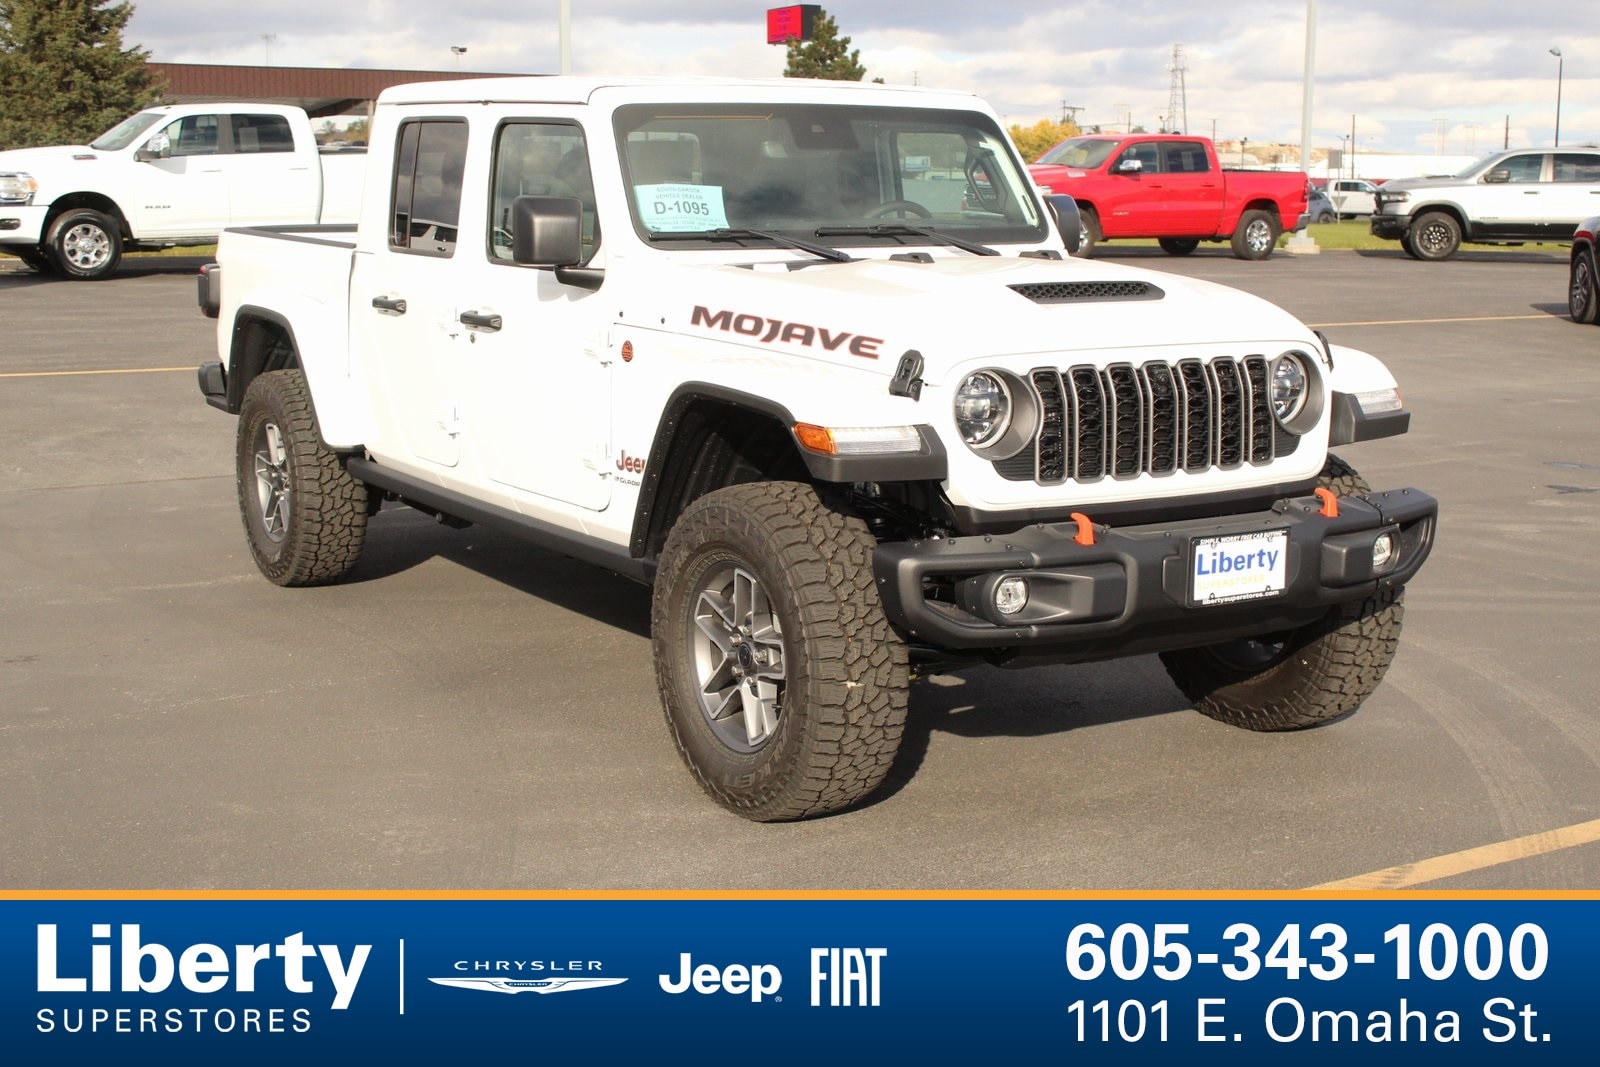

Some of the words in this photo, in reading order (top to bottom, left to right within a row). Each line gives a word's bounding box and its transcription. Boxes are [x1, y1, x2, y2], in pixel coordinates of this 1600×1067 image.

[653, 200, 710, 216] D-1095
[691, 305, 884, 360] MOJAVE
[1197, 548, 1279, 575] Liberty
[1202, 590, 1279, 605] libertysuperstores.com
